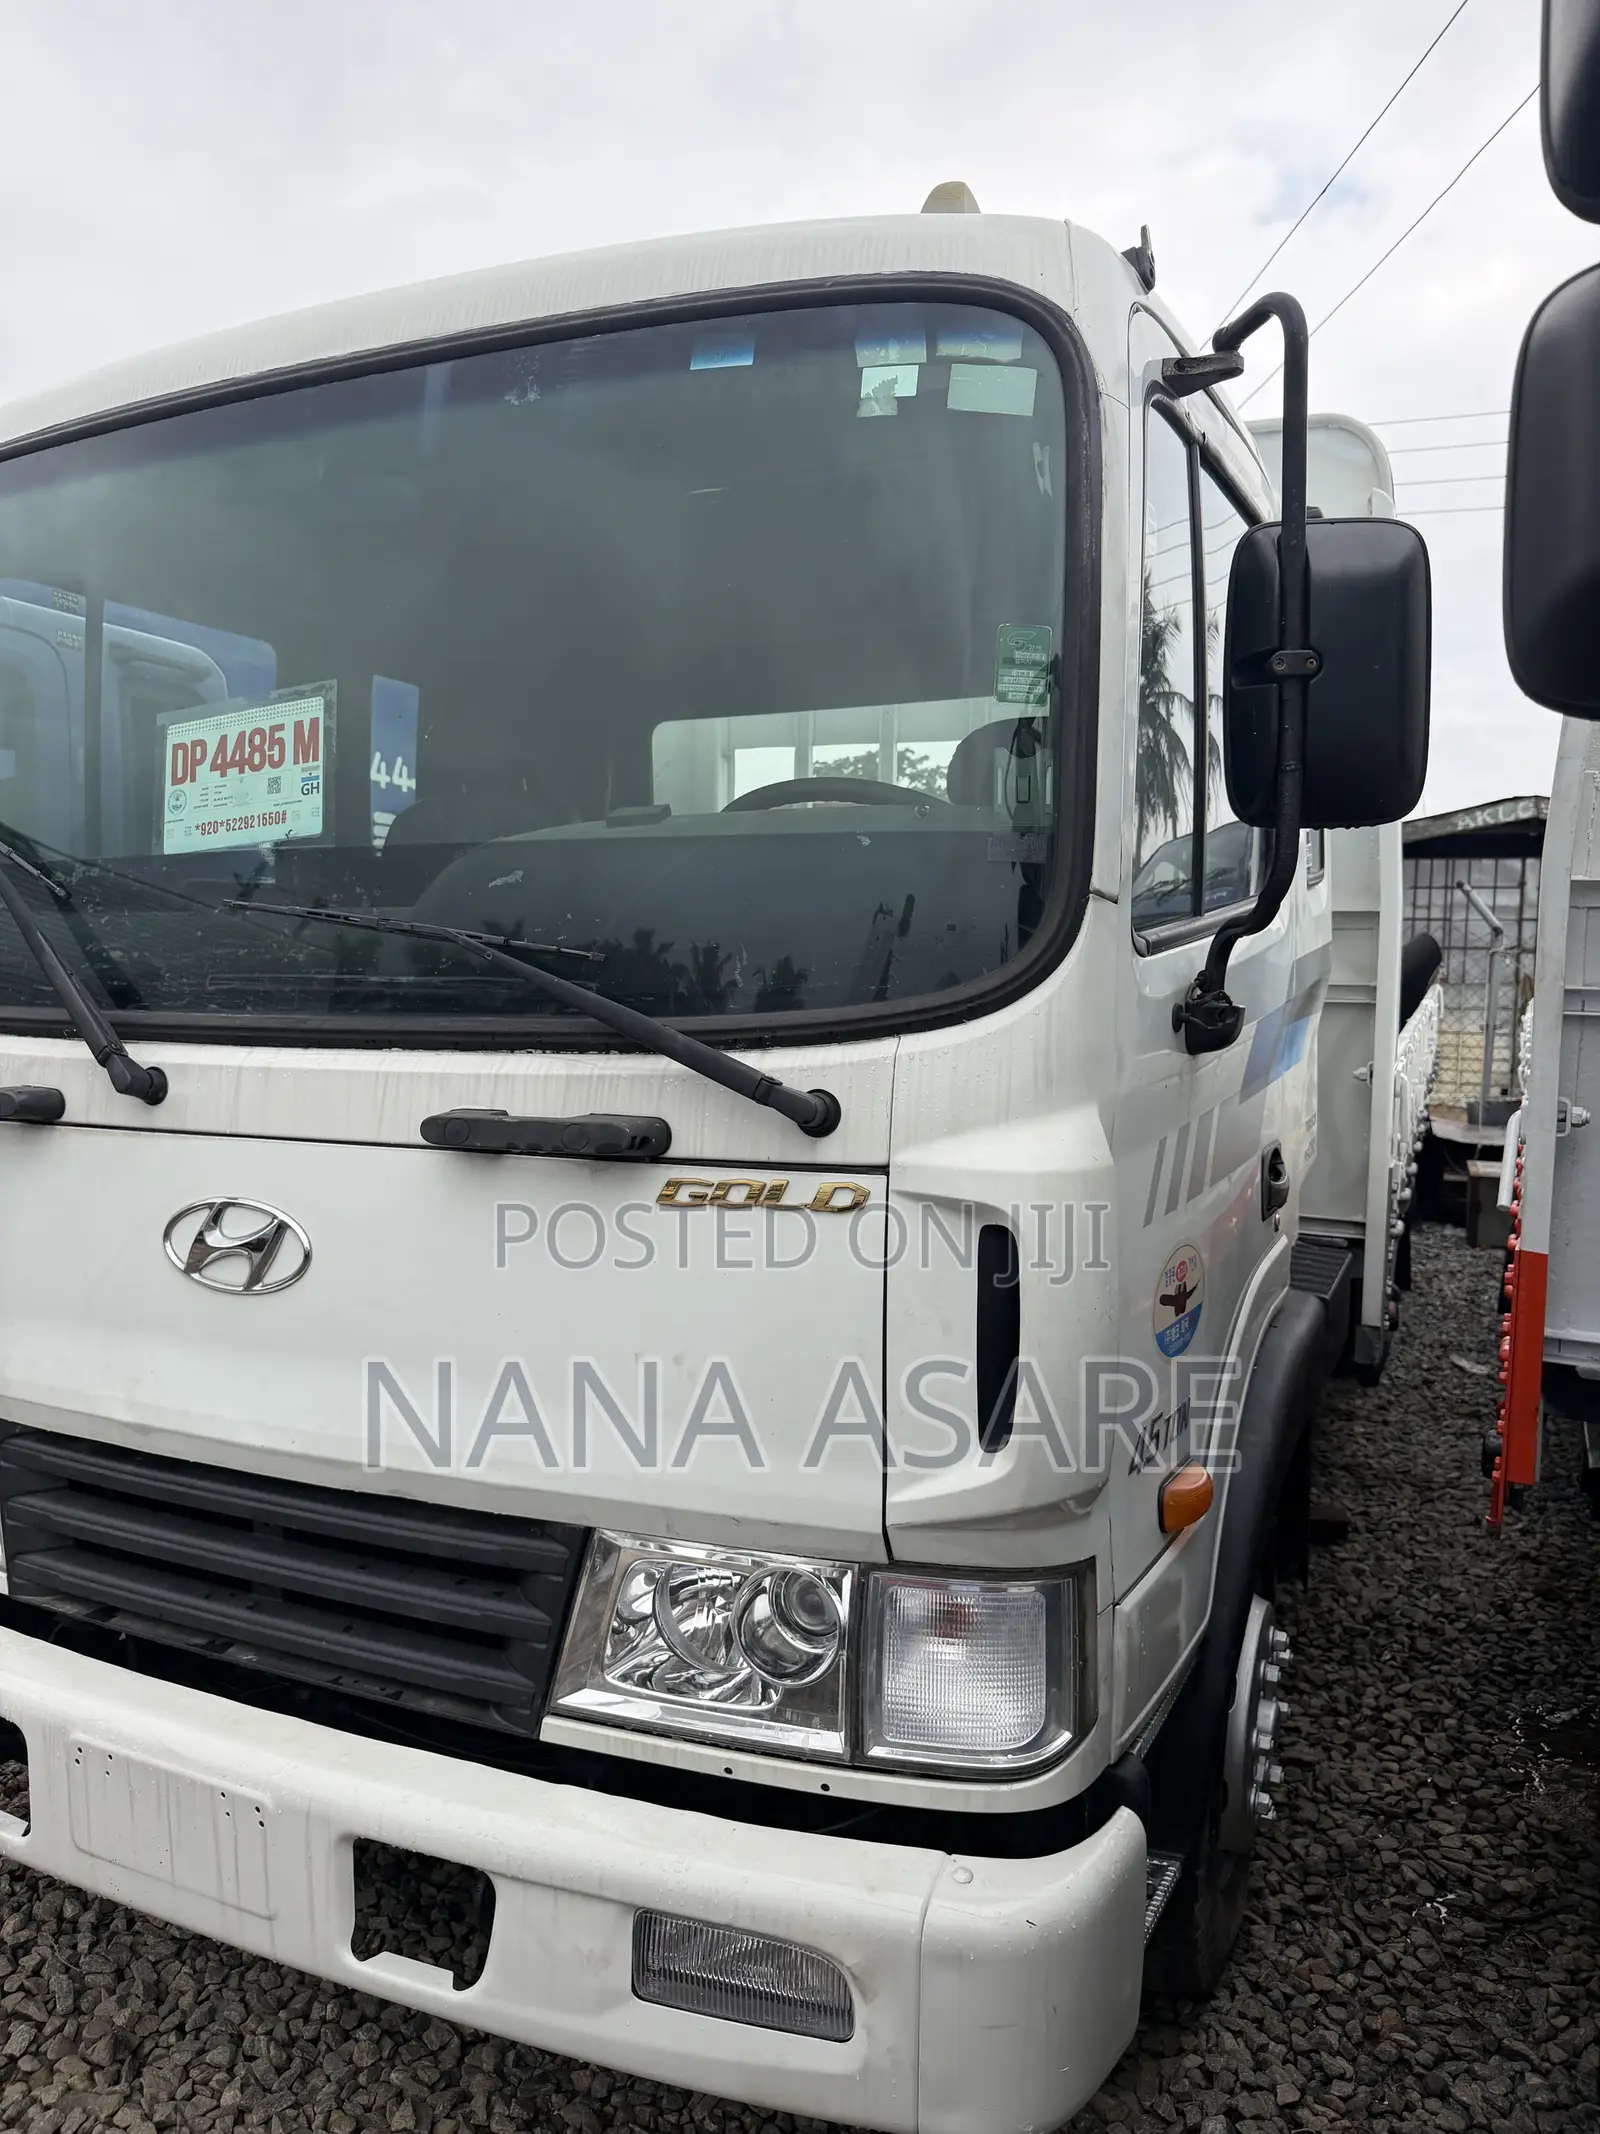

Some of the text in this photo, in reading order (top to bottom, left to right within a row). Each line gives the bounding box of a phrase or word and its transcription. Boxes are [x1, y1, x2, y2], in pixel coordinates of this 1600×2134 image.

[171, 717, 320, 786] DP 4485 M
[301, 781, 320, 796] GH
[656, 1178, 871, 1213] GOLD
